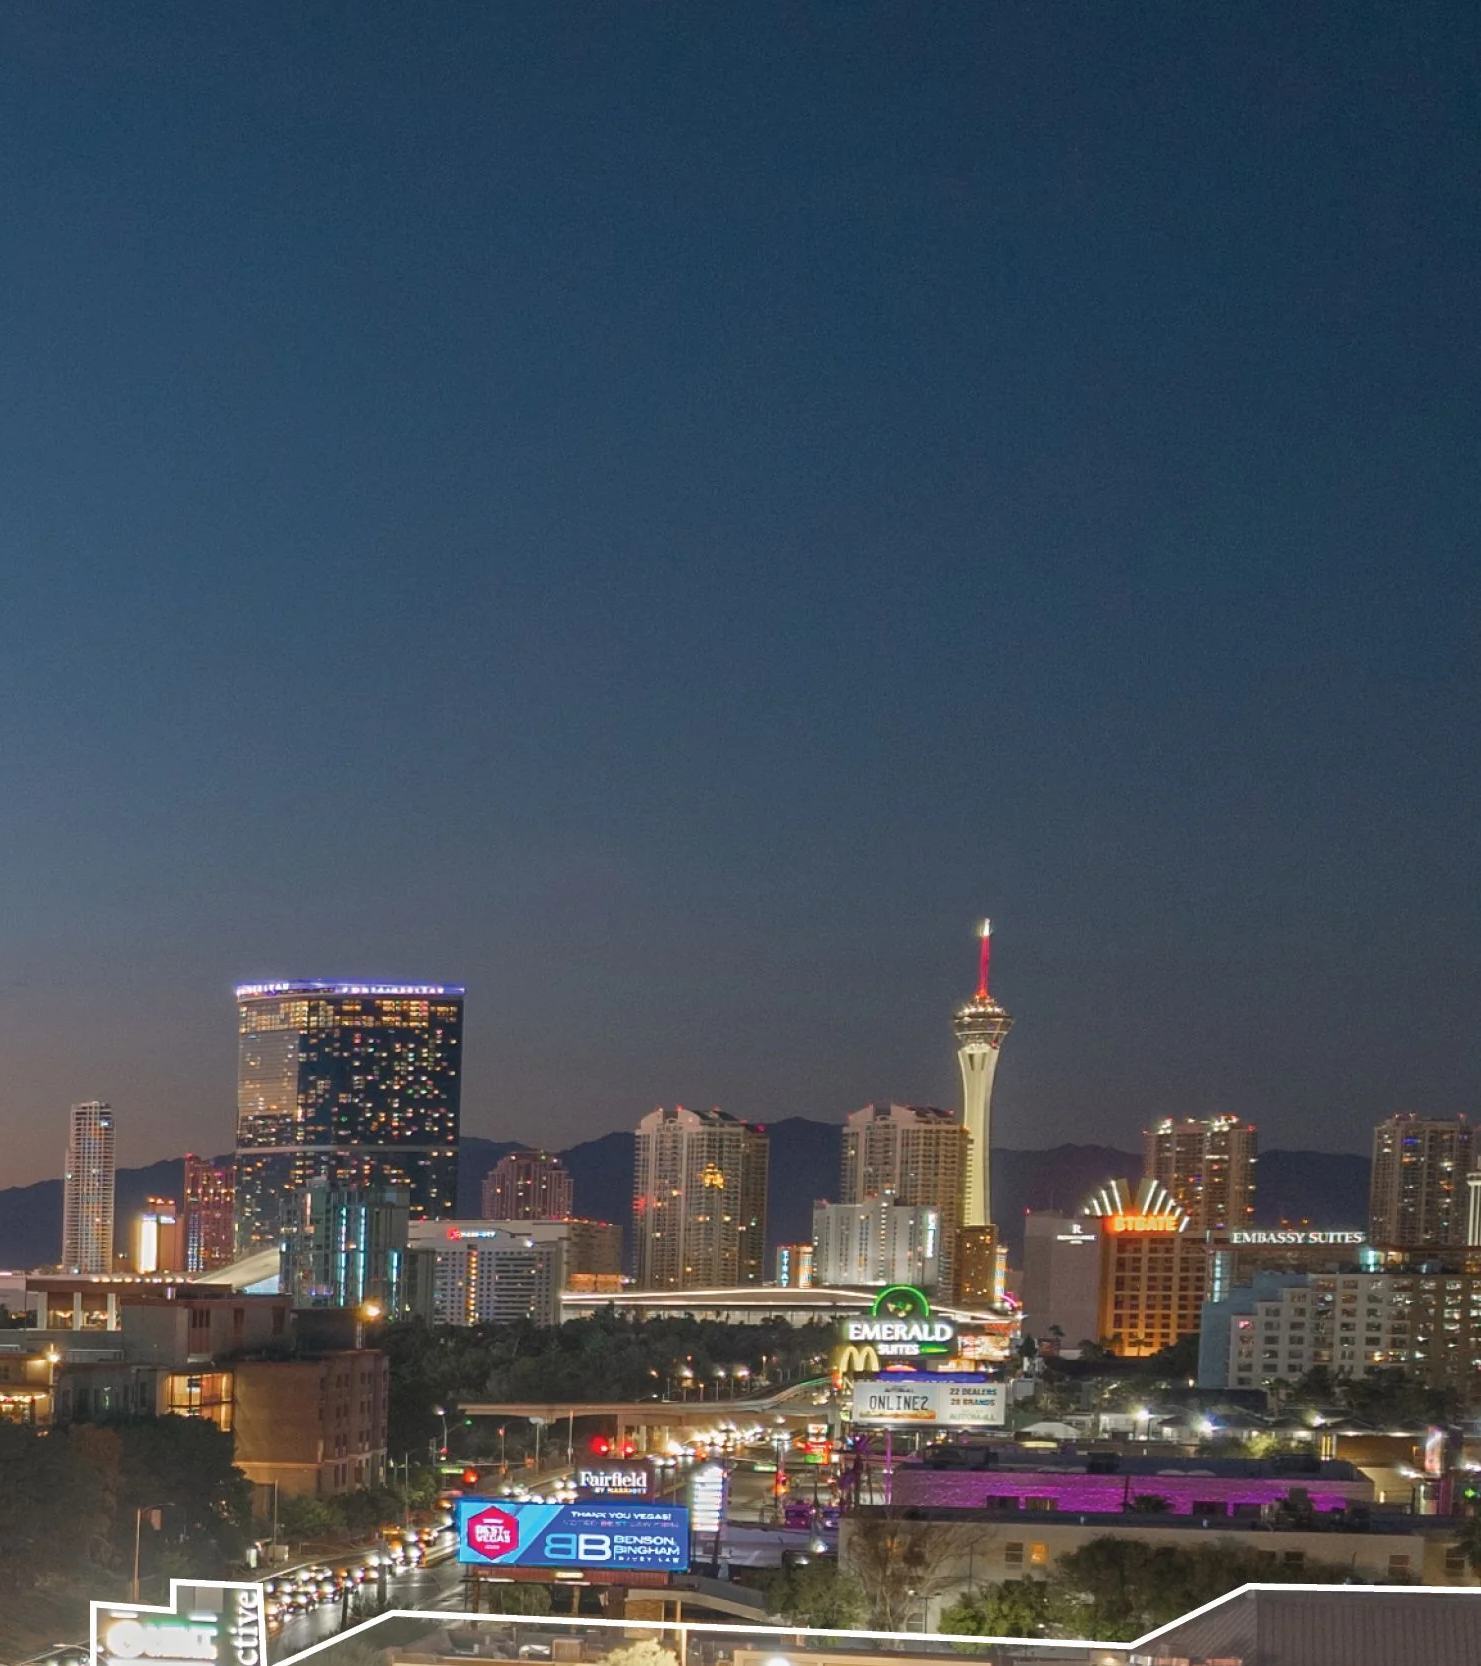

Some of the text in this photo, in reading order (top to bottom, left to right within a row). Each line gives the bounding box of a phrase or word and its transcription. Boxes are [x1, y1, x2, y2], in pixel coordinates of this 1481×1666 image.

[1232, 1231, 1363, 1244] EMBASSY SUITES
[849, 1322, 953, 1342] EMERALD
[878, 1344, 920, 1355] SUITES
[581, 1471, 647, 1487] Fairfield
